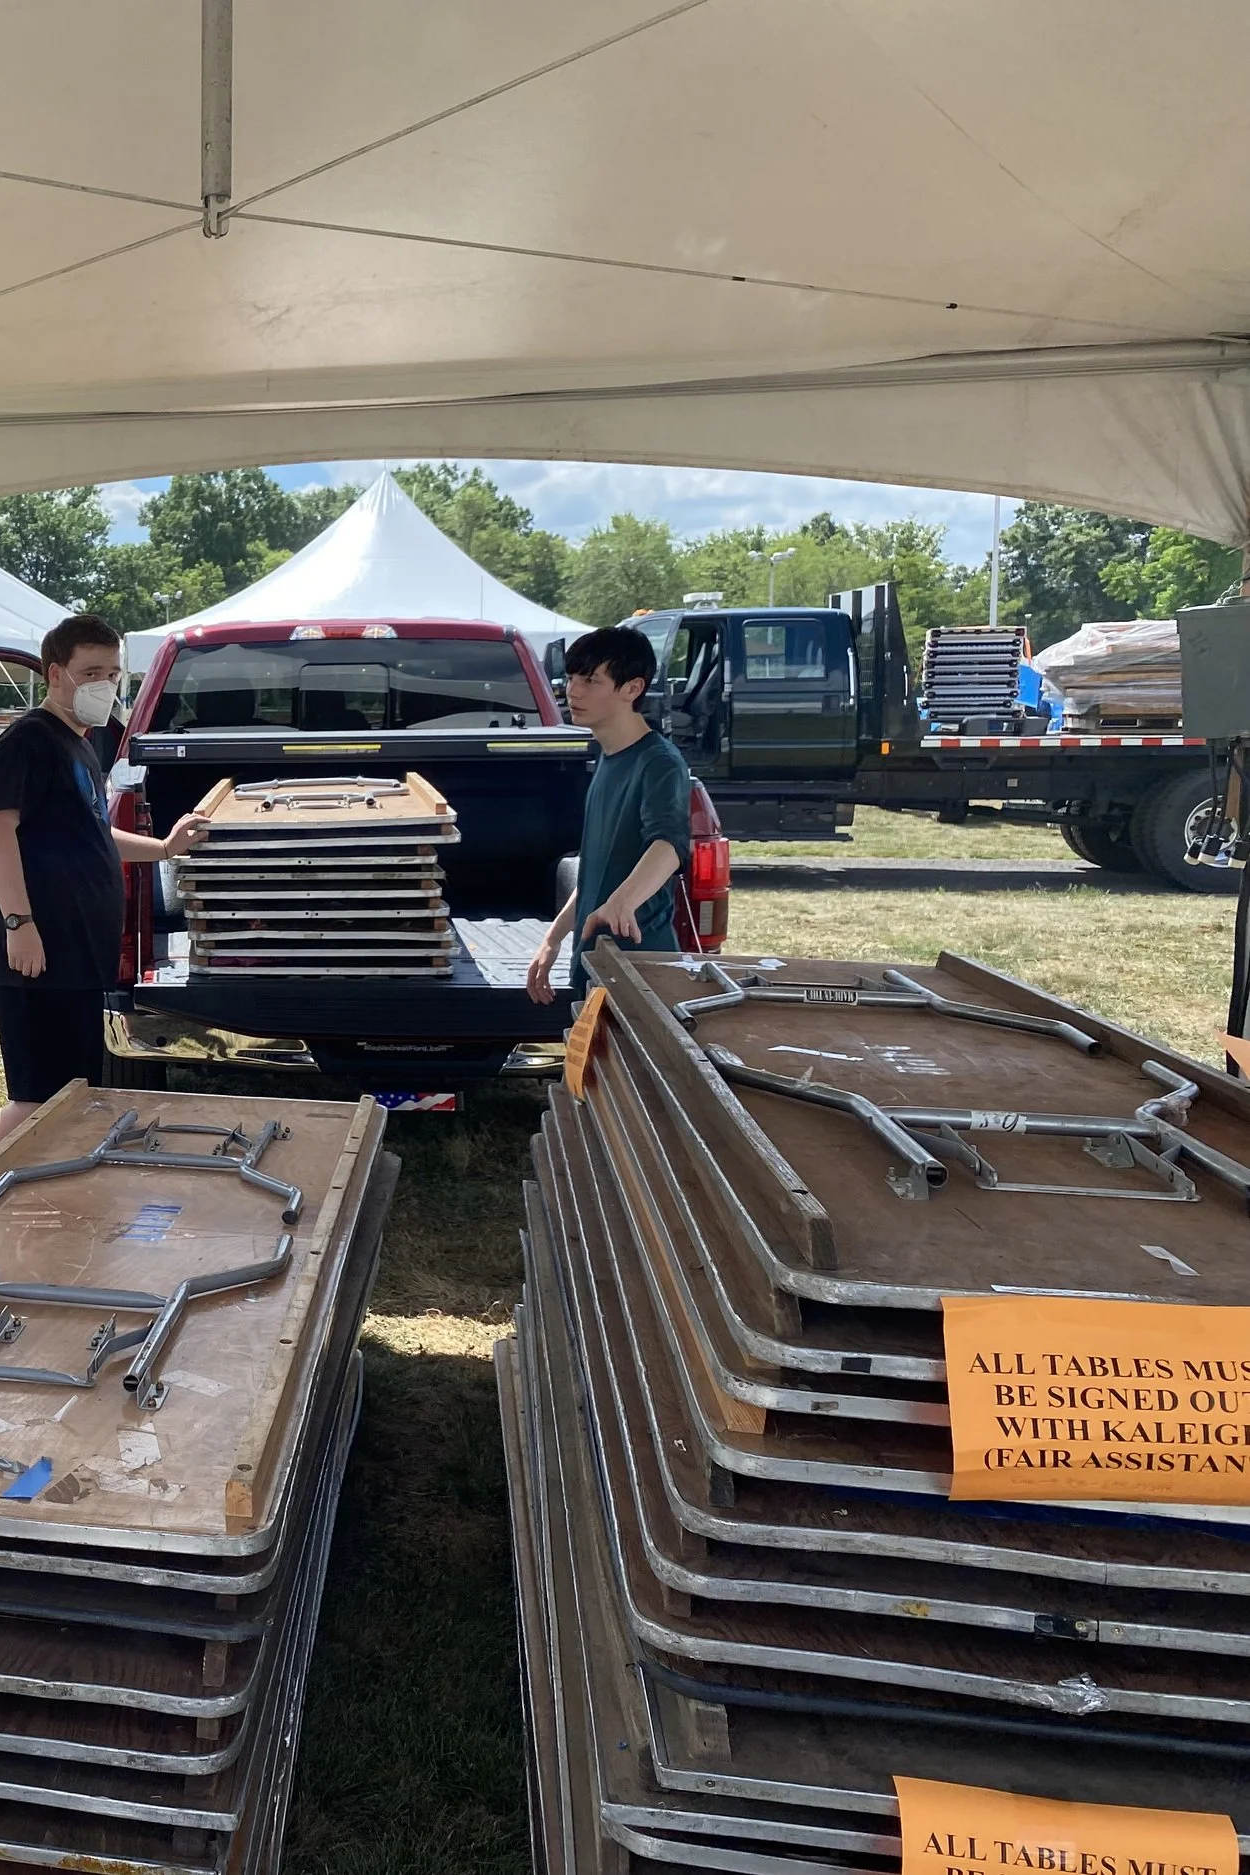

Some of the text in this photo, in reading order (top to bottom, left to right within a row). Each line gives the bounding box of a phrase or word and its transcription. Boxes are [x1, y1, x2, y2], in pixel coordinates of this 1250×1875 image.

[968, 1352, 1036, 1375] ALL
[1042, 1354, 1174, 1379] TABLES
[994, 1384, 1037, 1407] BE
[1047, 1386, 1179, 1412] SIGNED
[995, 1416, 1091, 1441] WITH
[984, 1448, 1250, 1473] (FAIR ASSISTAN
[922, 1832, 987, 1862] ALL
[993, 1840, 1118, 1875] TABLES
